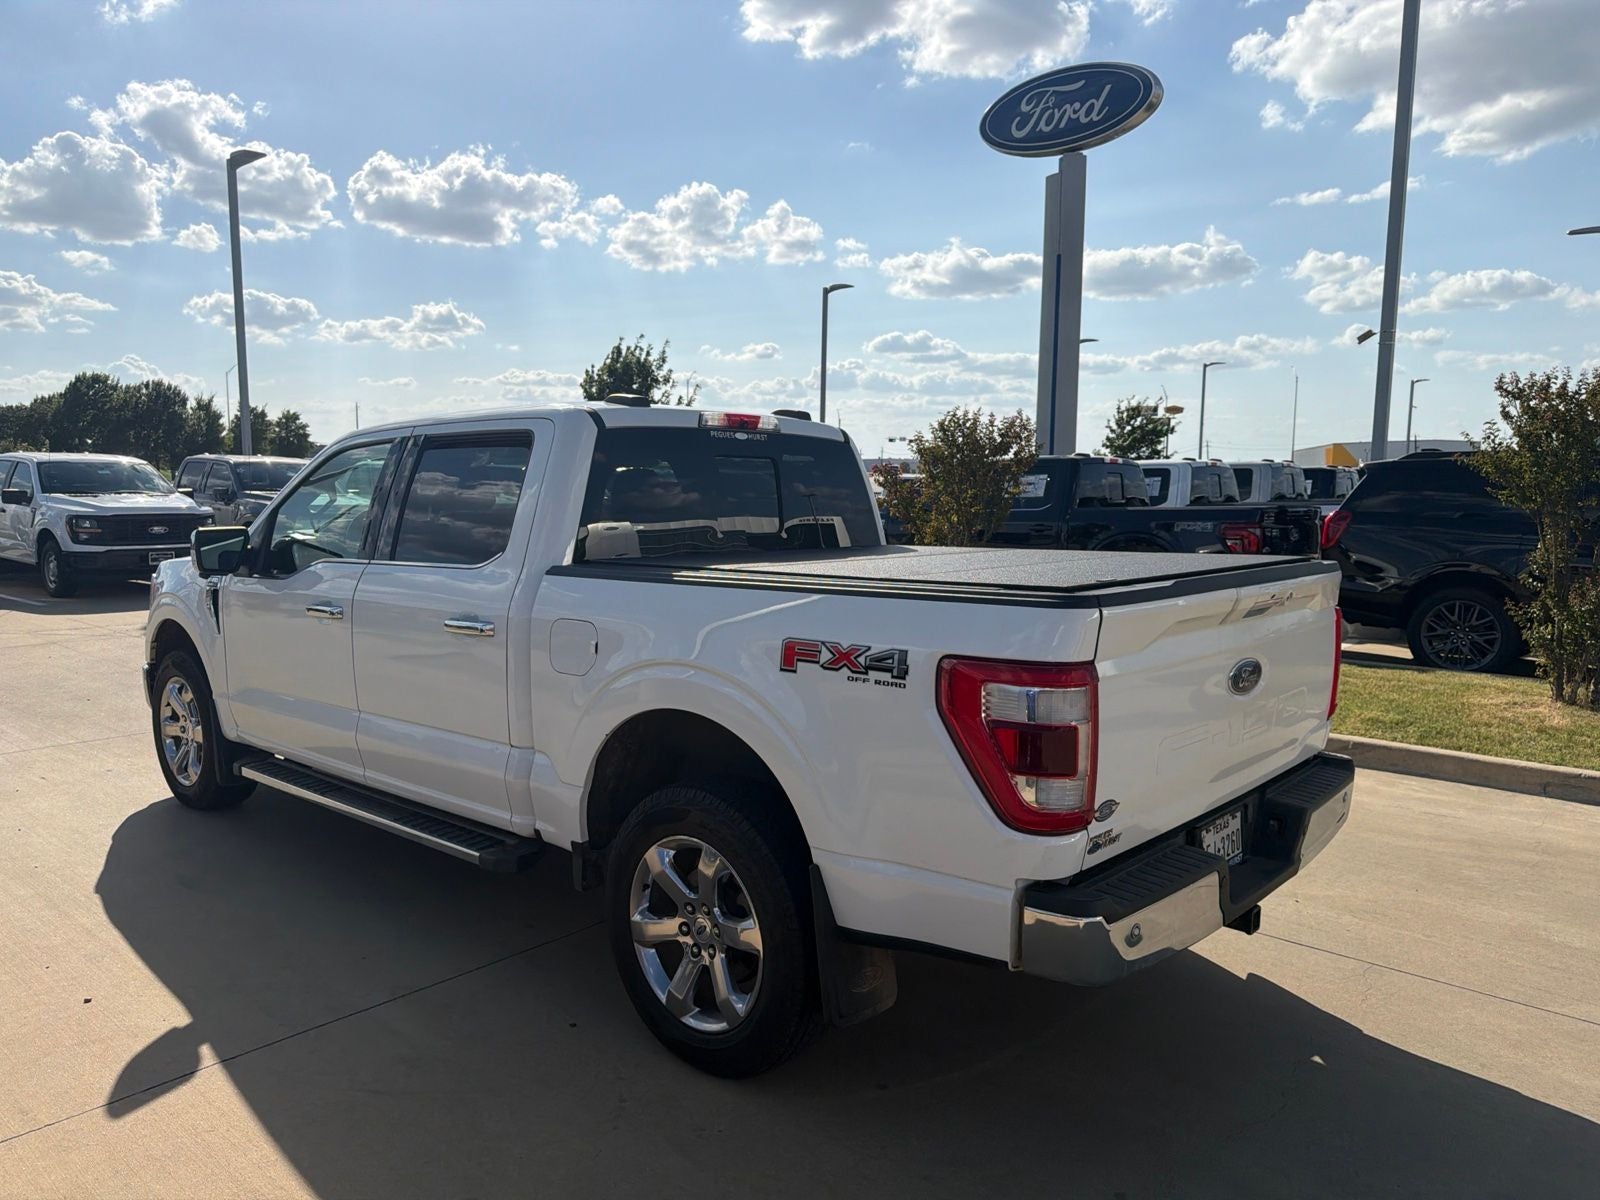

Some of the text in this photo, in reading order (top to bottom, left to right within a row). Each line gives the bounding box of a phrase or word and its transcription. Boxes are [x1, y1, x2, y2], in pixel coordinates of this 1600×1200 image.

[1011, 79, 1112, 138] Ford
[710, 430, 768, 441] PEGUES HURST
[779, 637, 909, 680] FX4
[847, 675, 907, 689] OFF ROAD
[1212, 819, 1230, 836] TEXAS
